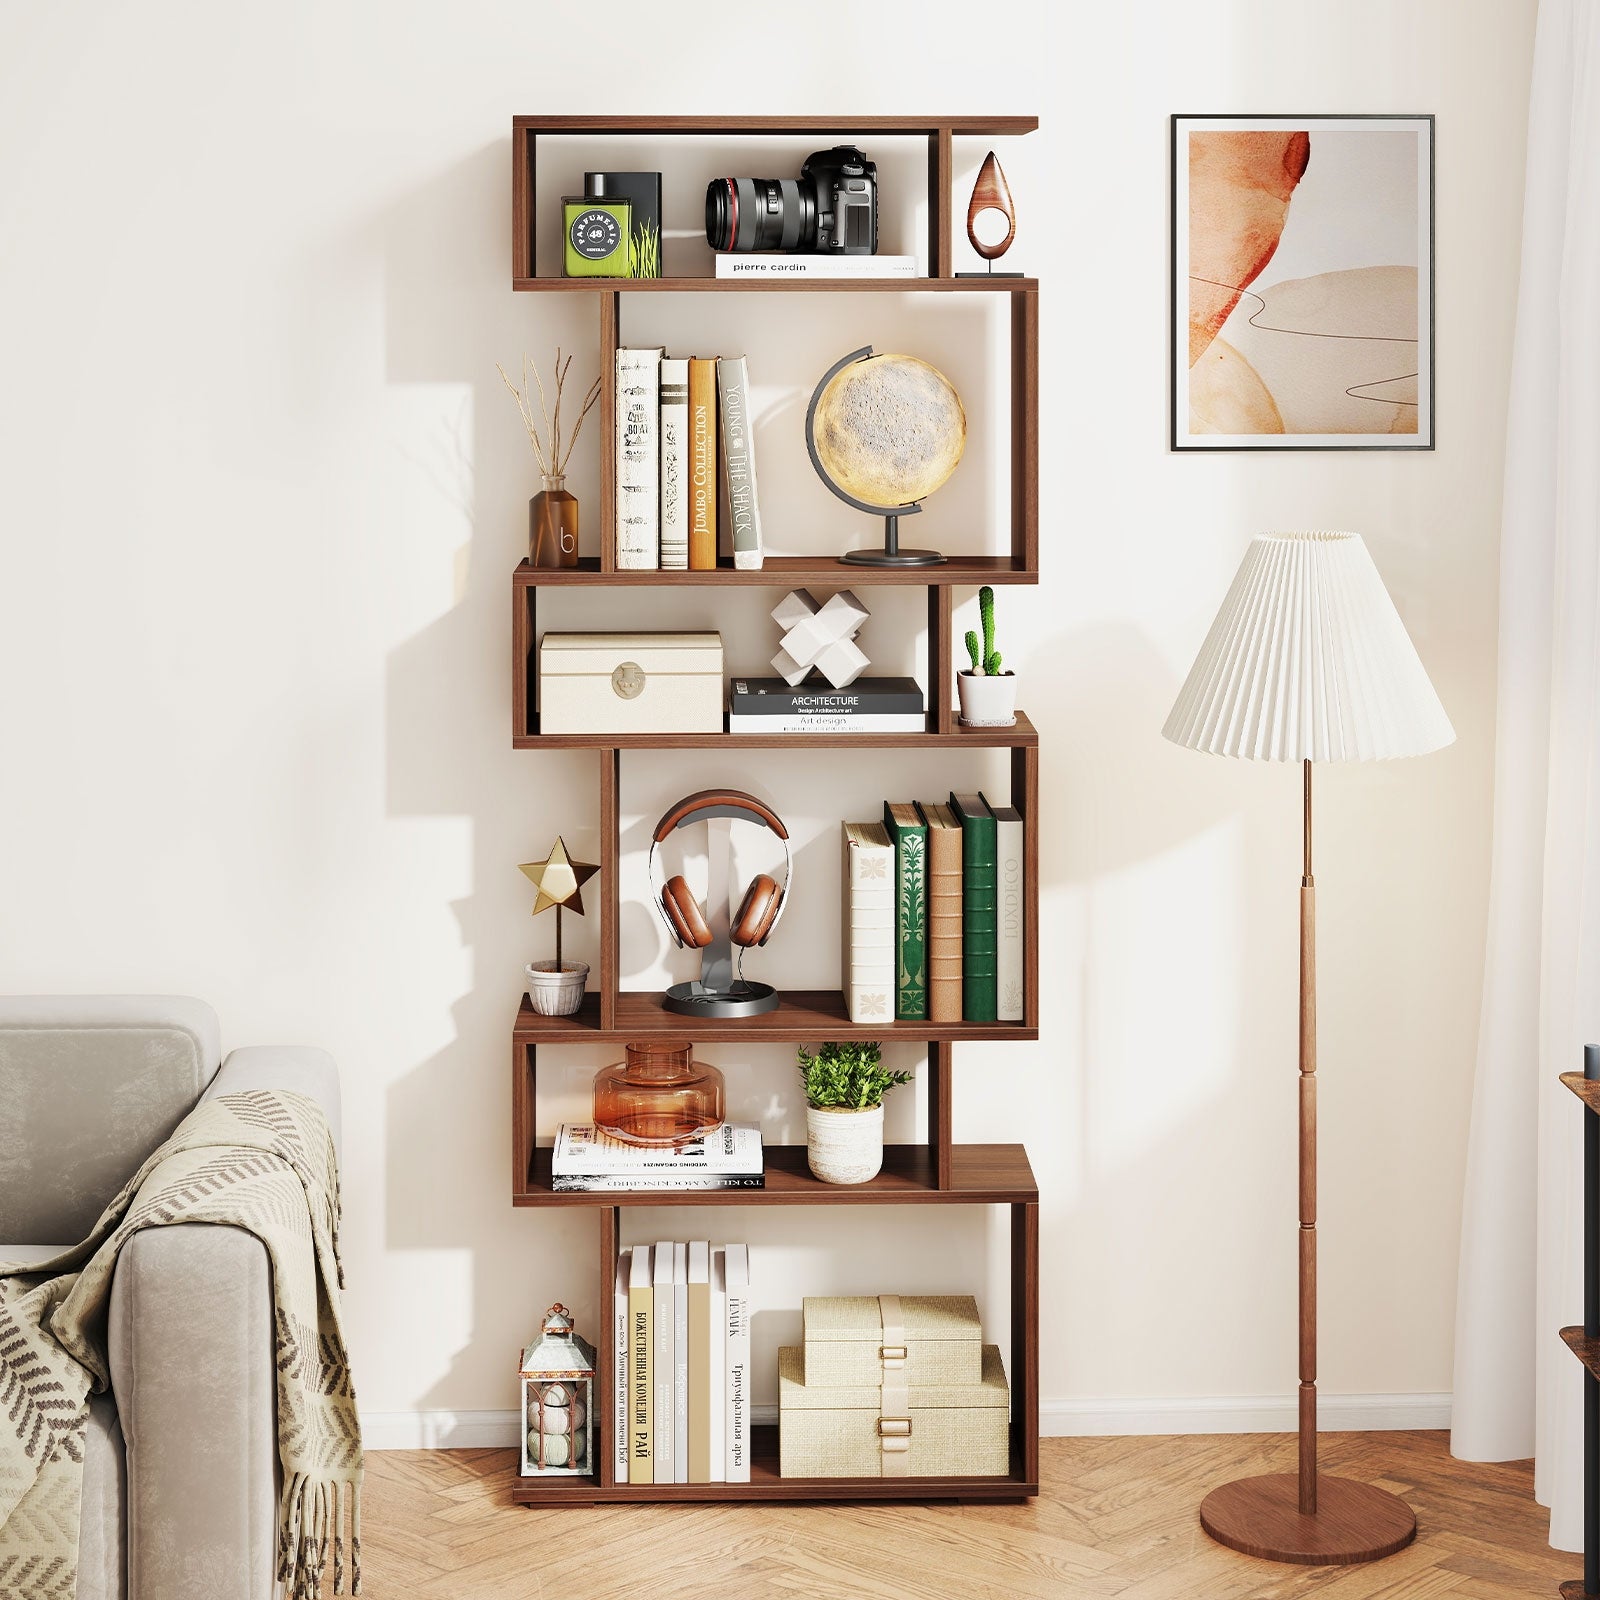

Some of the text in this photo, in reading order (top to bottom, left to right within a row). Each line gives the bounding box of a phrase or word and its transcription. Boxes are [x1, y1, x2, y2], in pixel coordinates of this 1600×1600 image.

[576, 214, 617, 246] PARFUMERIE
[589, 229, 603, 239] 48
[733, 263, 767, 272] pierre
[770, 263, 807, 271] cardin
[725, 384, 753, 535] YOUNG THE SHACK
[693, 405, 710, 534] JUMBO COLLECTION
[560, 526, 575, 554] b
[791, 696, 859, 706] ARCHITECTURE
[800, 716, 847, 726] Art design
[1004, 858, 1019, 940] LUXDECO
[702, 1179, 712, 1187] A
[715, 1179, 740, 1187] KILL
[743, 1179, 763, 1187] TO
[618, 1350, 628, 1389] Уличный
[635, 1312, 651, 1459] БОЖЕСТВЕННАЯ КОМЕДИЯ РАЙ
[618, 1407, 625, 1417] по
[731, 1363, 744, 1467] Триумфальная арка
[618, 1447, 628, 1464] Боб
